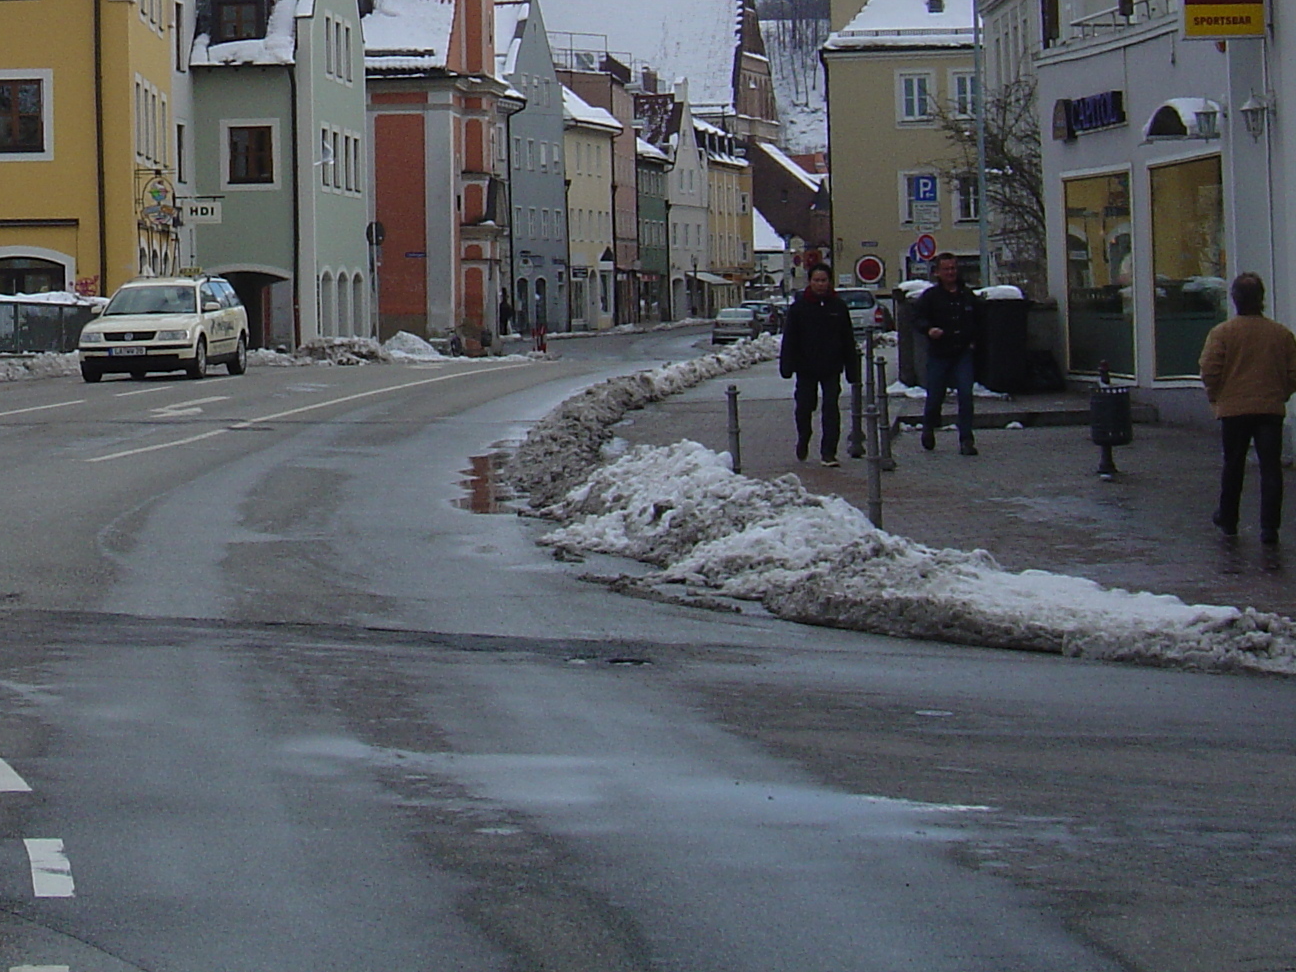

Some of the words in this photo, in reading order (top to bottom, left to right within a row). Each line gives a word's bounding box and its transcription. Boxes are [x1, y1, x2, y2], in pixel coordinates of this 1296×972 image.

[1193, 16, 1252, 26] SPORTSBAR
[919, 179, 932, 199] P
[190, 206, 215, 216] HDI
